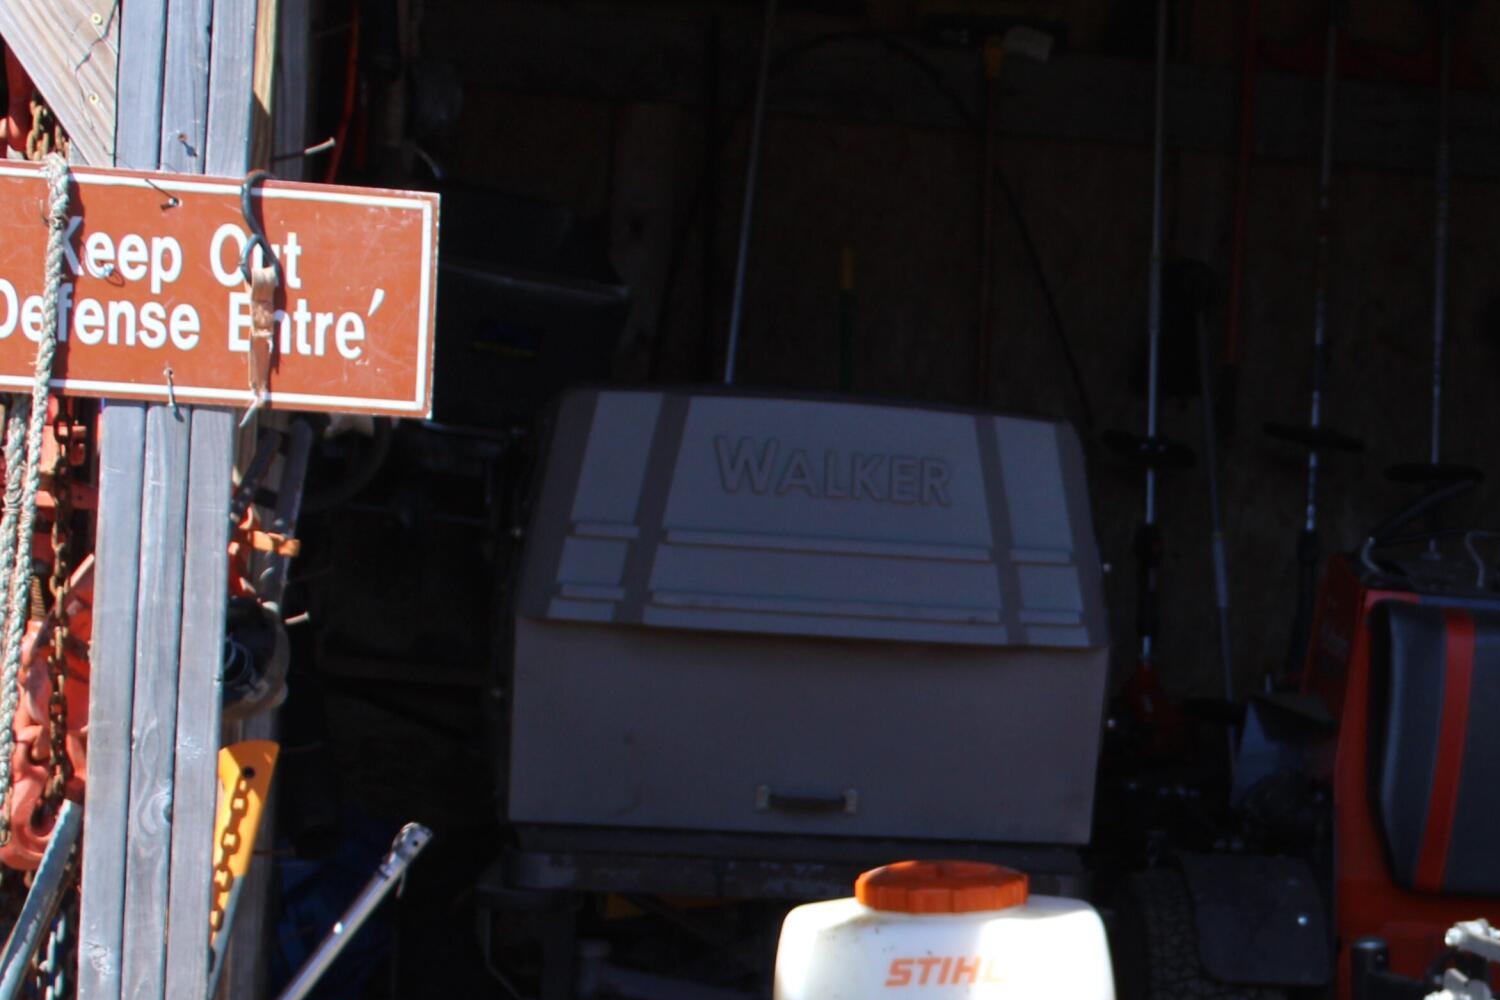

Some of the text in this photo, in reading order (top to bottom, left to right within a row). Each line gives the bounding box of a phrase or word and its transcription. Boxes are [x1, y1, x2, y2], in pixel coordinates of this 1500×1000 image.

[62, 215, 183, 295] Keep
[713, 435, 952, 508] WALKER
[884, 955, 1006, 988] STIHL
